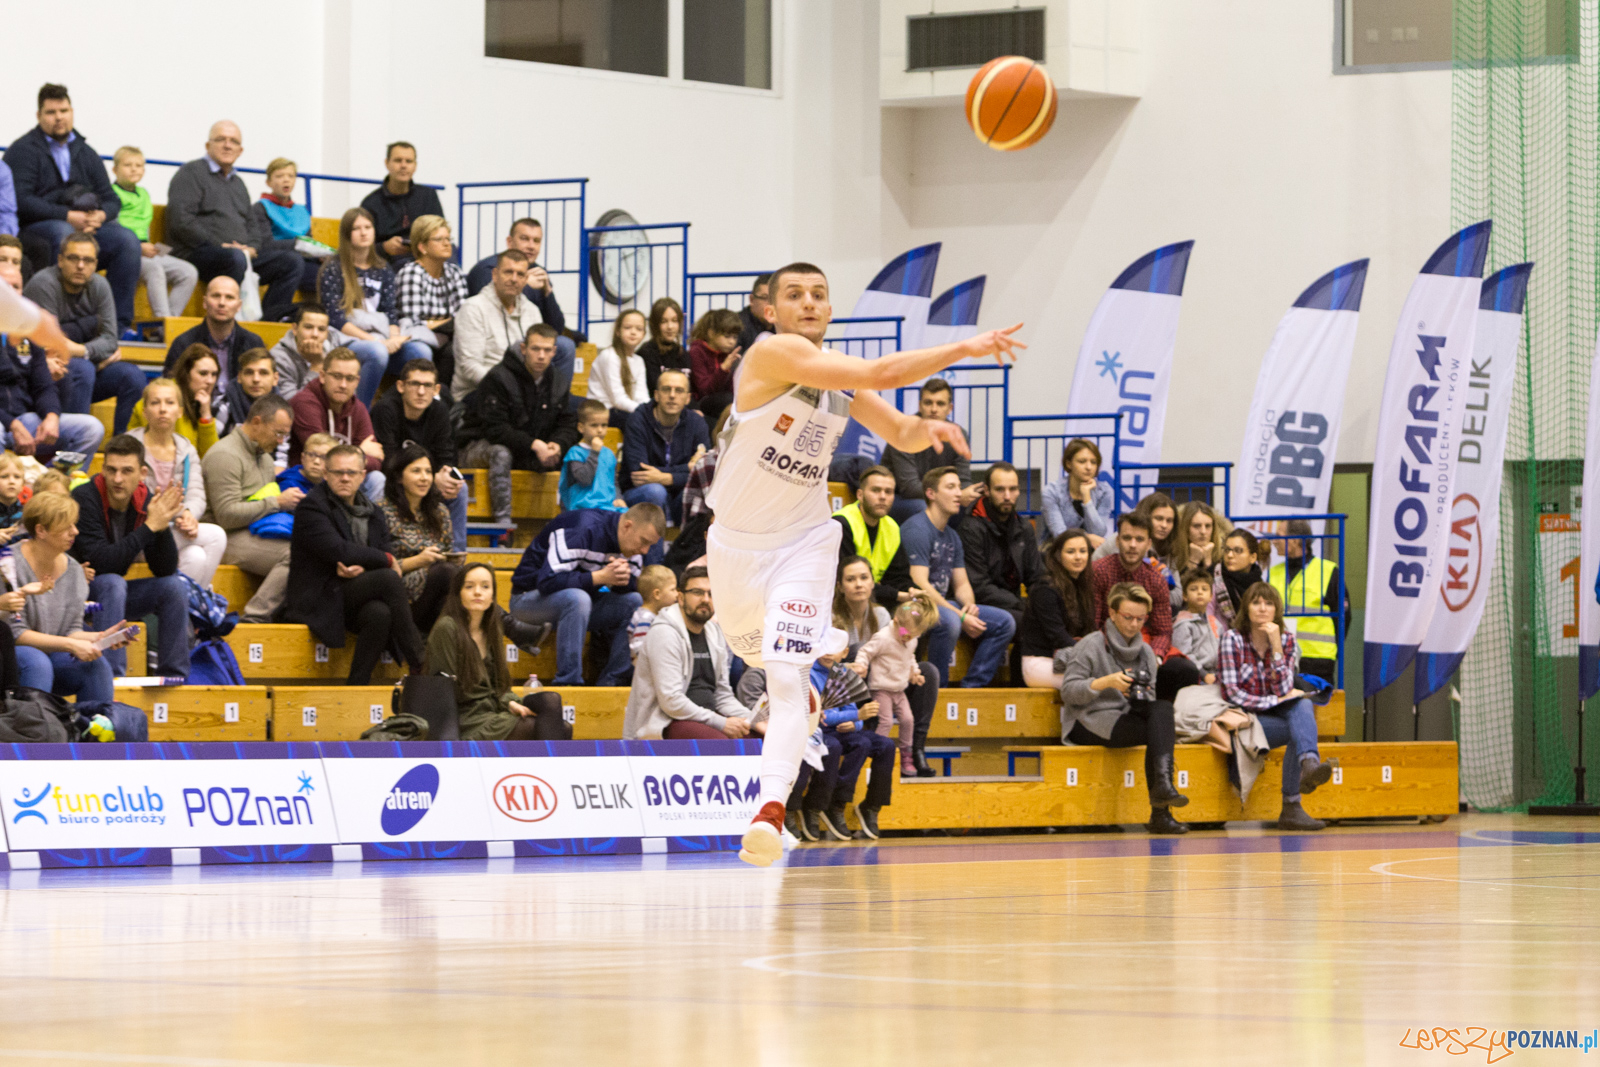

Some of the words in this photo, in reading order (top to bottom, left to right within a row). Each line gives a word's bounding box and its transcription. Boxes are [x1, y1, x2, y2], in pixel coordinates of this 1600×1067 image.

[1458, 356, 1492, 464] DELIK
[1248, 409, 1276, 505] fundacja
[1265, 410, 1328, 509] PBG
[1389, 334, 1447, 598] BIOFARM
[1447, 515, 1477, 590] KIA
[787, 602, 812, 616] KIA
[776, 621, 814, 637] DELIK
[158, 706, 164, 719] 2
[230, 706, 235, 718] 1
[52, 785, 164, 813] funclub
[386, 787, 433, 810] atrem
[502, 785, 549, 811] KIA
[571, 783, 633, 810] DELIK
[59, 814, 100, 825] biuro
[106, 813, 166, 826] podróży
